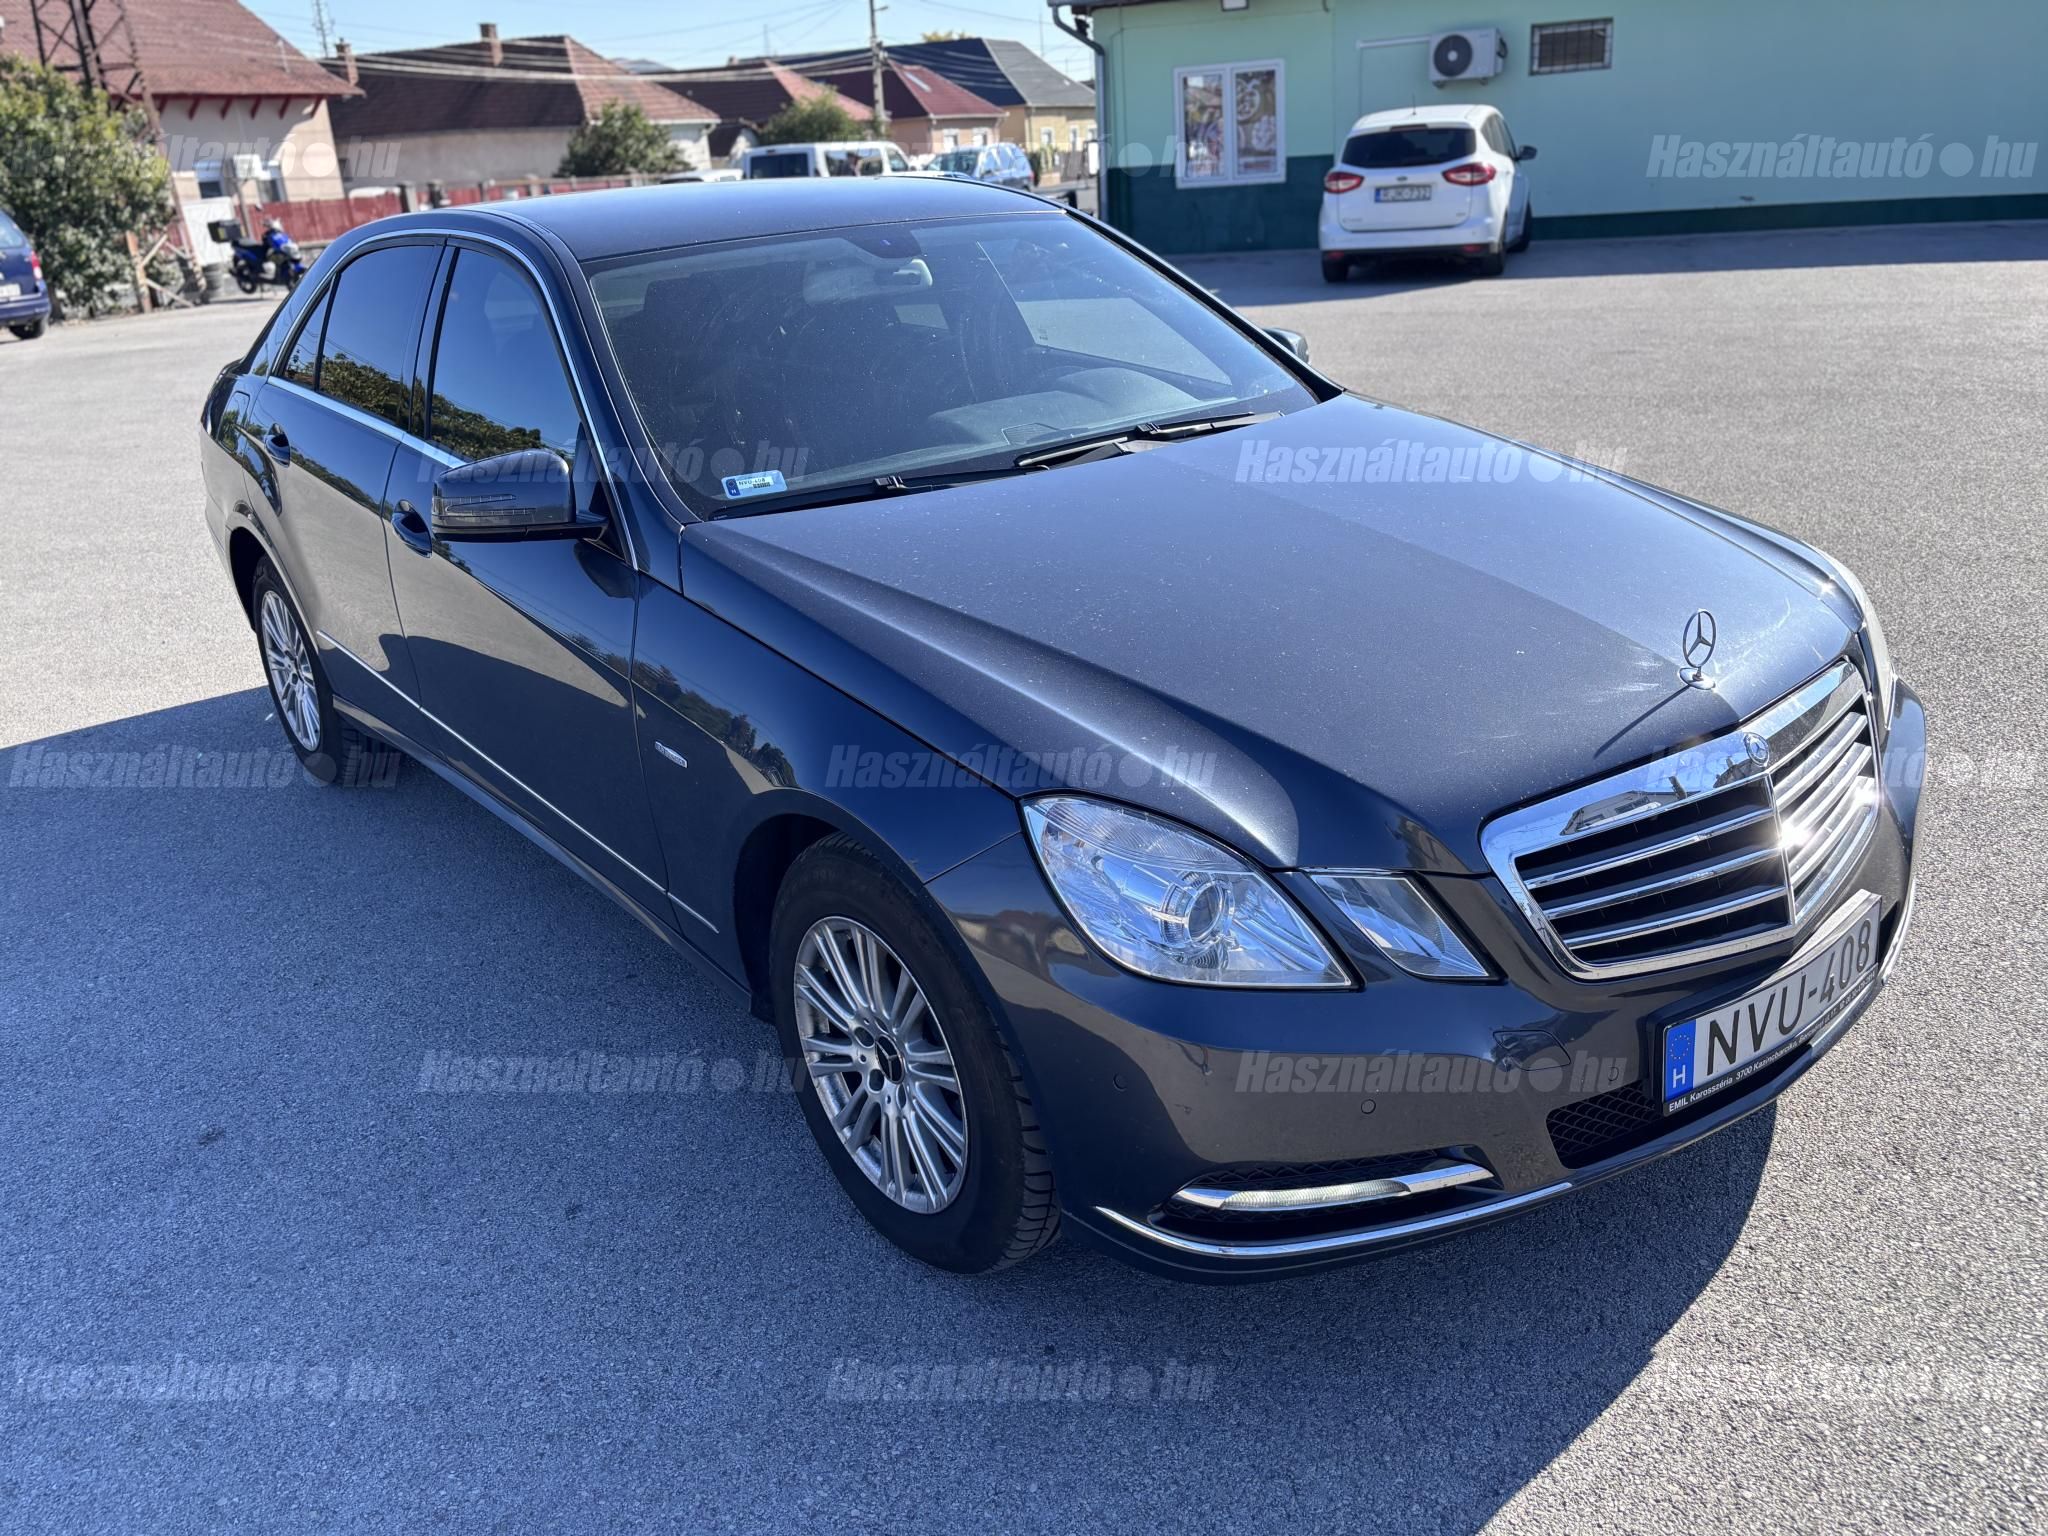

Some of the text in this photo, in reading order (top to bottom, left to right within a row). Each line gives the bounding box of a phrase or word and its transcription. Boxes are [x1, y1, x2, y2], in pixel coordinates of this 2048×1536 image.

[1706, 918, 1872, 1077] NVU-408
[1669, 1097, 1689, 1112] EMIL
[1690, 1076, 1733, 1103] Karosszéria
[1735, 1065, 1753, 1080] 3700
[1672, 1065, 1686, 1088] H
